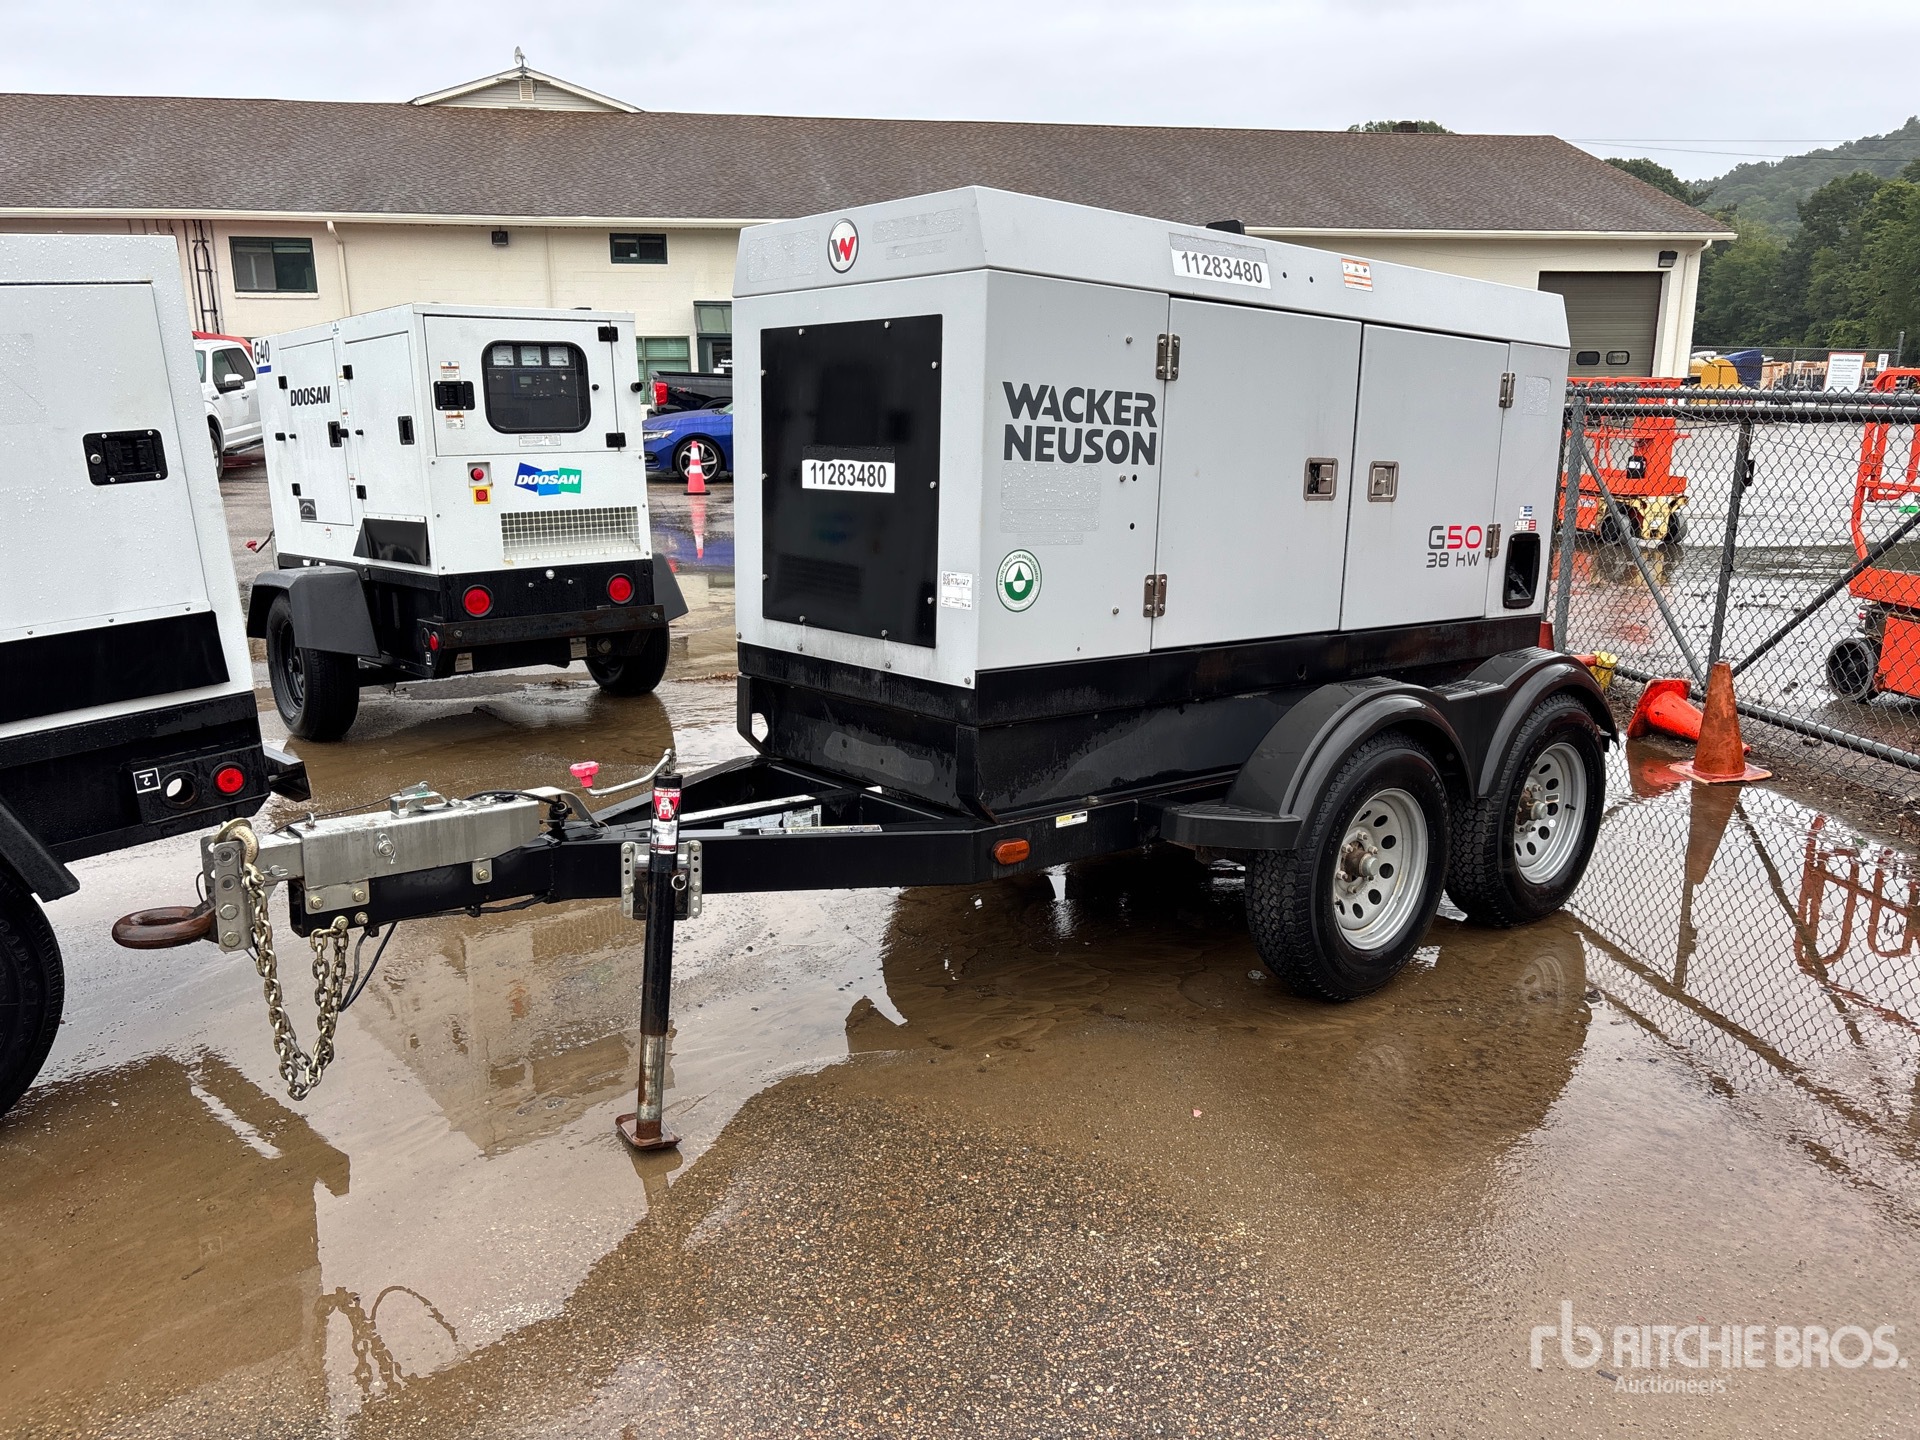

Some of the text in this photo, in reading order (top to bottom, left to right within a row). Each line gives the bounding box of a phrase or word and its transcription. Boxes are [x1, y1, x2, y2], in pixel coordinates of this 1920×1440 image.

[1181, 251, 1263, 284] 11283480
[254, 339, 271, 366] G40
[290, 385, 331, 407] DOOSAN
[1002, 381, 1158, 428] WACKER
[1003, 424, 1157, 466] NEUSON
[516, 474, 581, 486] DOOSAN
[810, 462, 887, 488] 11283480
[1428, 525, 1483, 550] G50
[1425, 552, 1450, 568] 38
